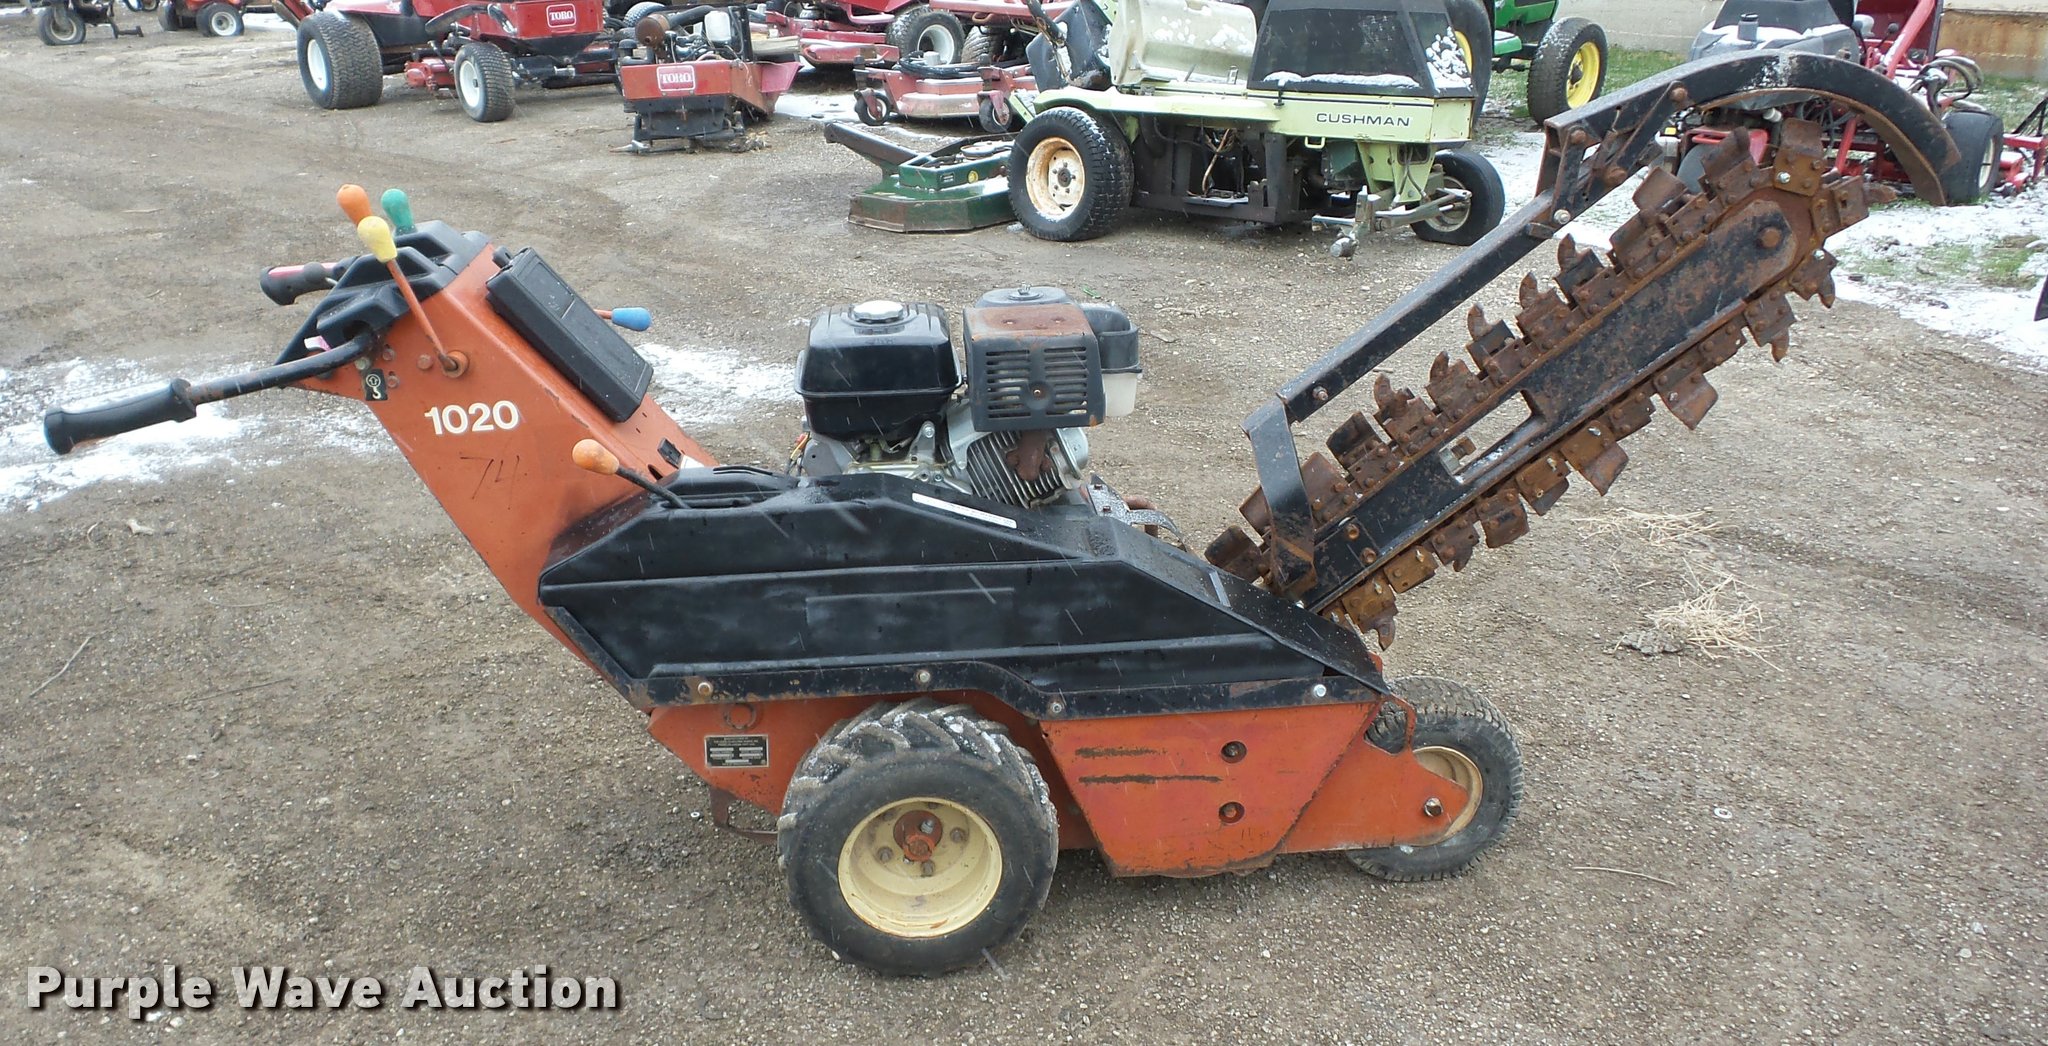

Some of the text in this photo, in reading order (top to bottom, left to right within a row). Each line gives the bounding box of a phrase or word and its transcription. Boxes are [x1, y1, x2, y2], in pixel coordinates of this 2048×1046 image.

[549, 10, 573, 20] TORO
[660, 73, 692, 84] TORO
[1316, 113, 1410, 126] CUSHMAN
[424, 400, 519, 435] 1020
